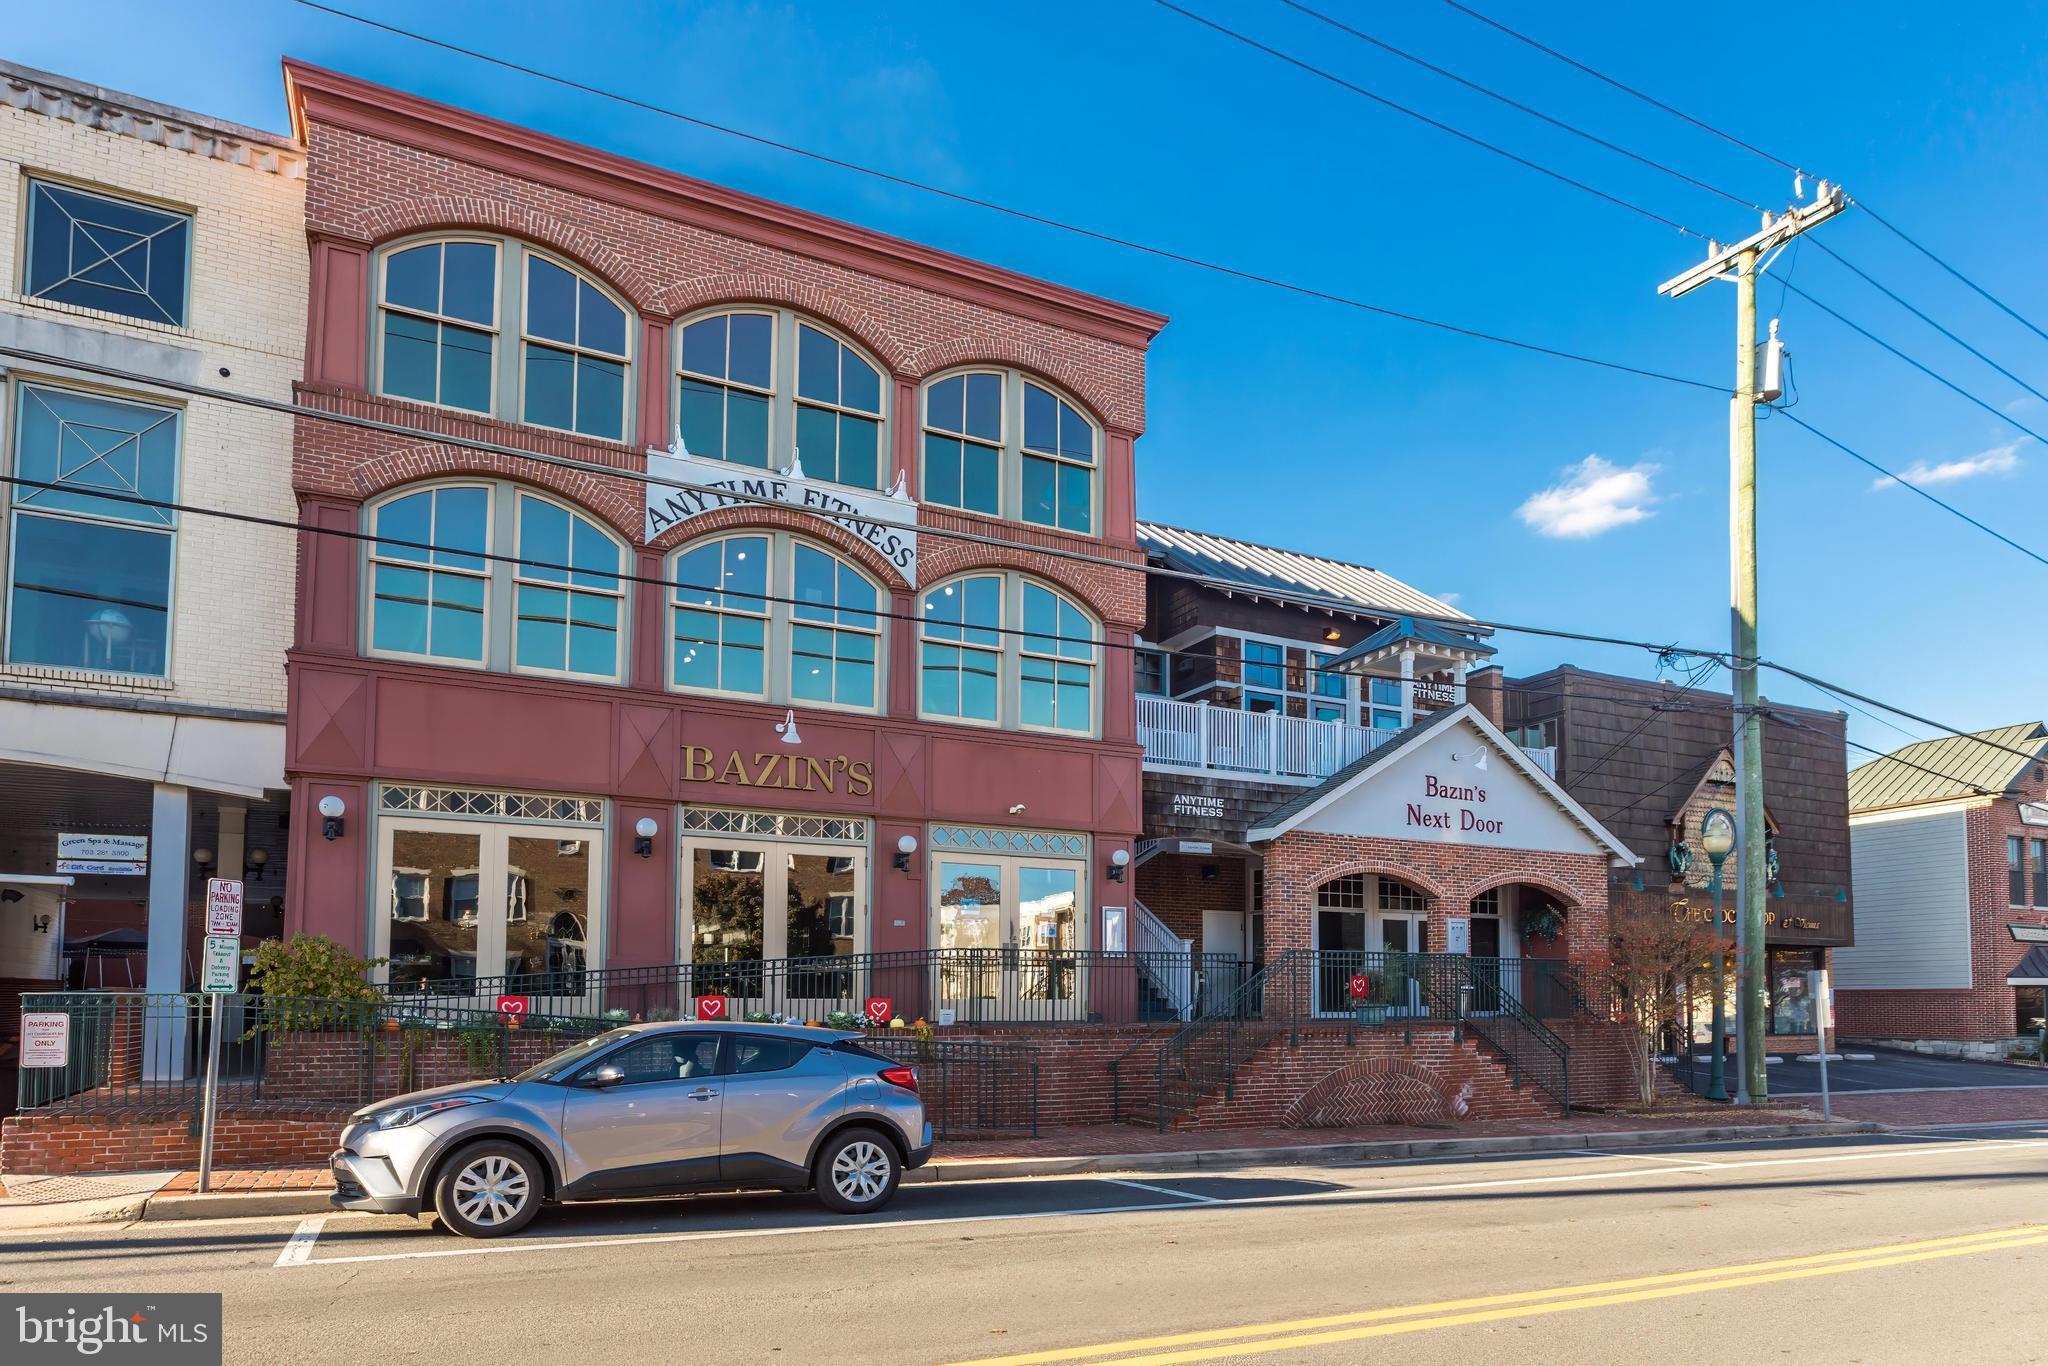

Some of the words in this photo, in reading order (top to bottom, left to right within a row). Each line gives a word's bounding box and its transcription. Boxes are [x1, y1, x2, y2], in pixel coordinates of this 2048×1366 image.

[648, 480, 788, 533] ANYTIME
[803, 488, 914, 568] FITNESS
[1413, 688, 1455, 703] FITNESS
[680, 744, 873, 796] BAZIN'S
[1425, 775, 1486, 802] Bazin's
[1173, 794, 1225, 808] ANYTIME
[1174, 805, 1224, 818] FITNESS
[1406, 803, 1451, 829] Next
[1460, 808, 1503, 834] Door
[62, 838, 86, 846] Green
[88, 838, 102, 846] Spa
[112, 839, 145, 849] Massage
[220, 882, 232, 892] NO
[211, 892, 239, 904] PARKING
[211, 904, 238, 913] LOADING
[209, 940, 216, 950] 5
